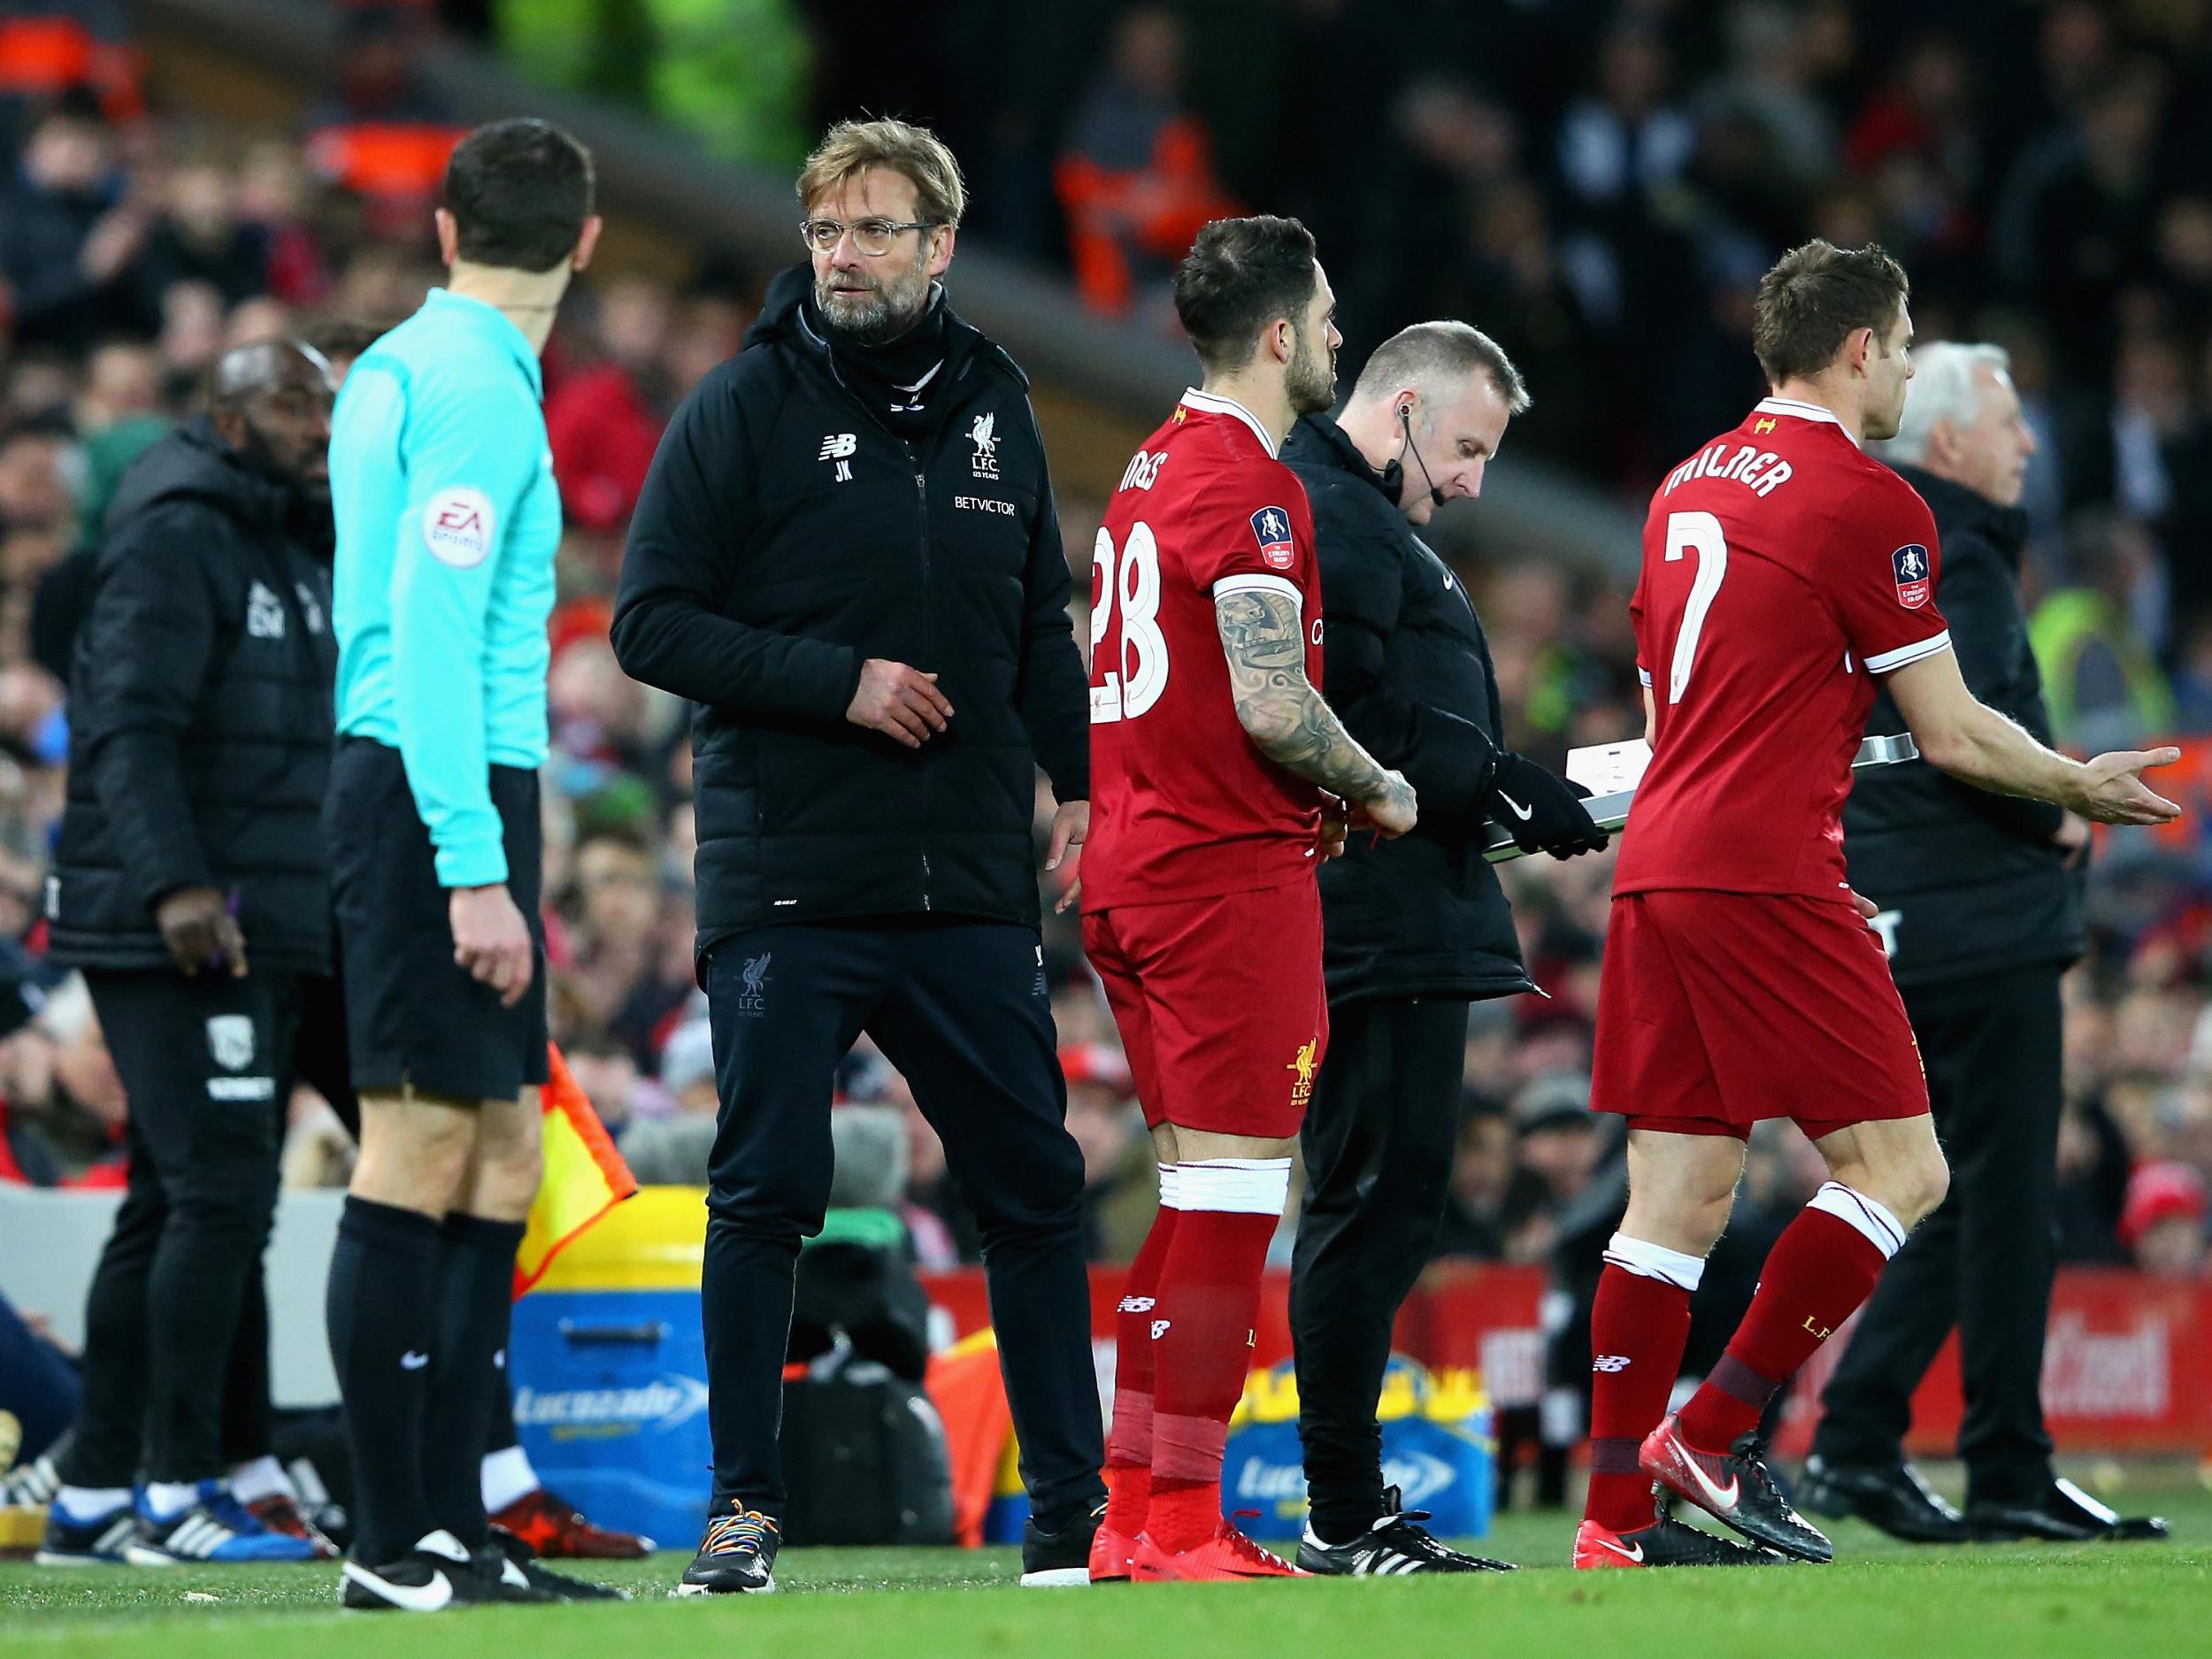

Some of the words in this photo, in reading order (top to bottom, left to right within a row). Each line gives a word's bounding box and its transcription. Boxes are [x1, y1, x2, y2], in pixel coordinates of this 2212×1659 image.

[835, 460, 853, 482] JK
[982, 472, 999, 480] YEARS
[1663, 444, 1793, 498] MILNER
[439, 501, 480, 532] EA
[955, 495, 1015, 517] BETVICTOR
[1089, 520, 1170, 725] 28
[1664, 510, 1728, 705] 7
